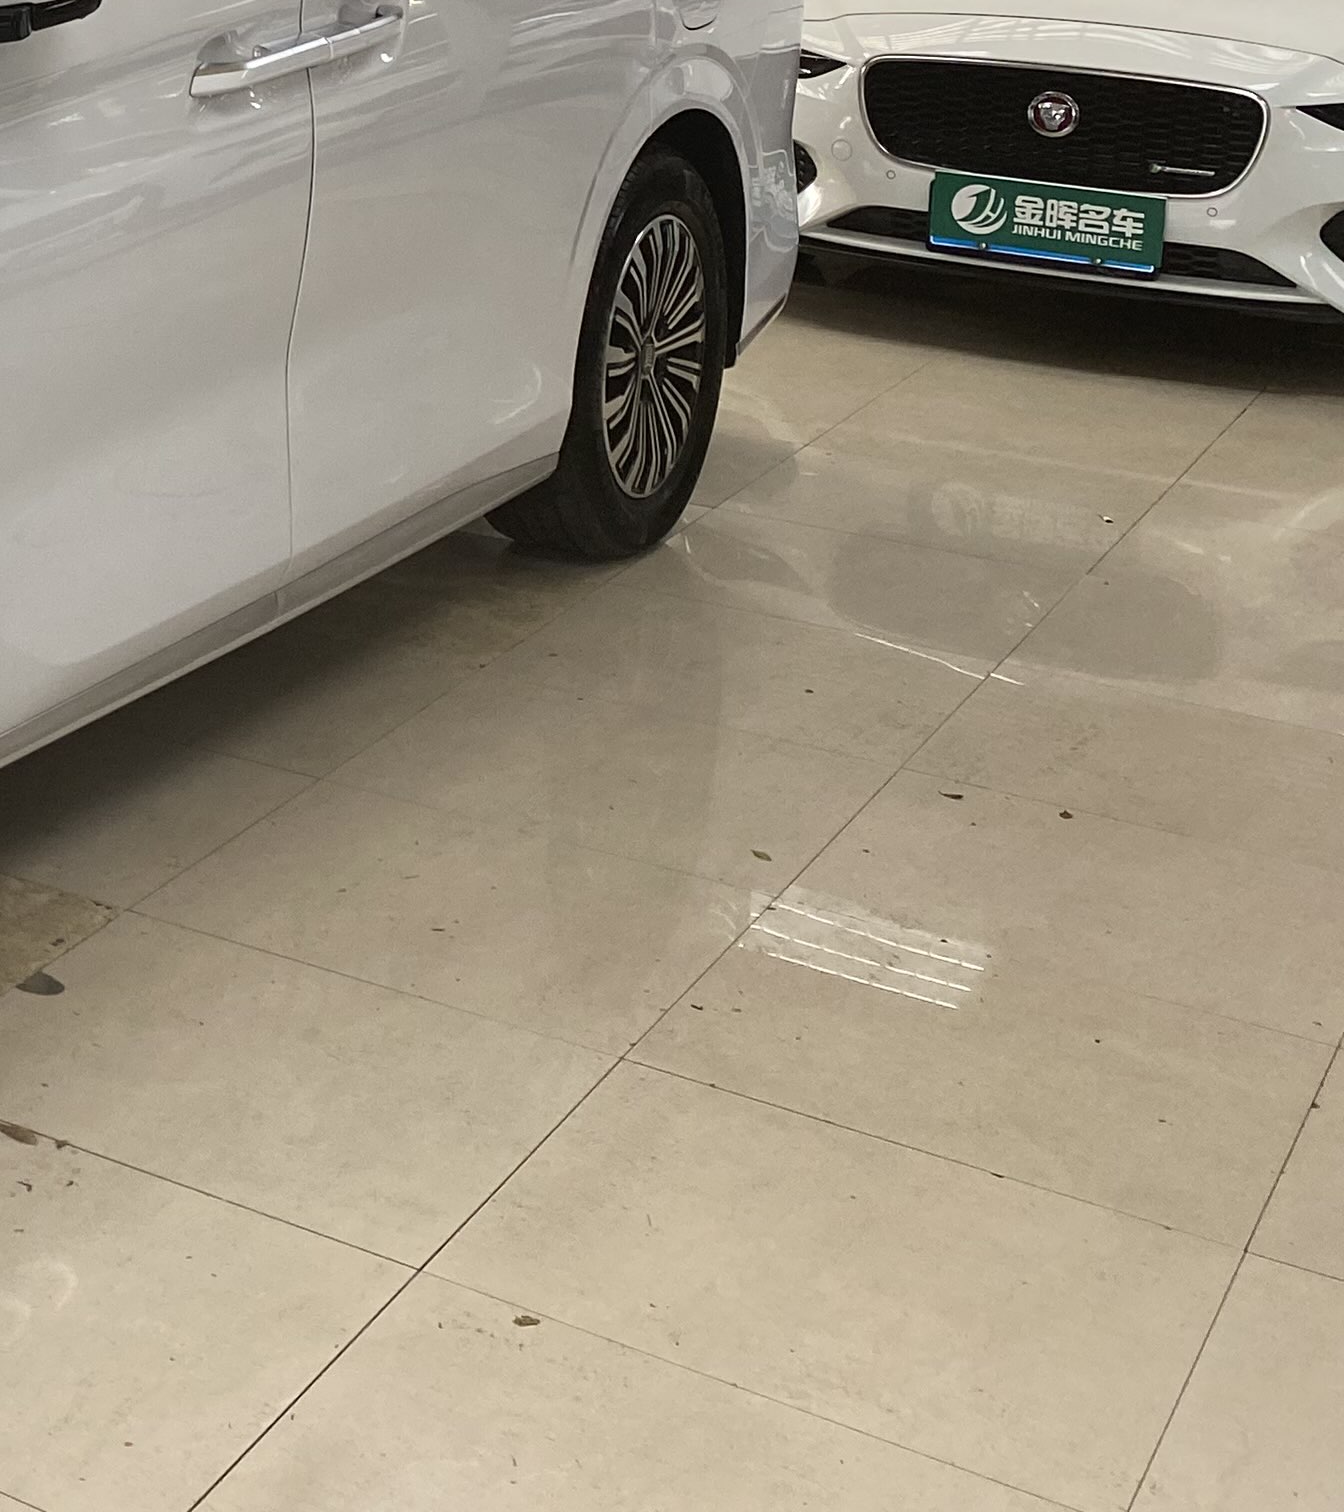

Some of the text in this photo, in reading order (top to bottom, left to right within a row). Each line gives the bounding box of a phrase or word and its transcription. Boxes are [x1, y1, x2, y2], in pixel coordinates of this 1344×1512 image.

[1013, 195, 1145, 237] 金晖名车
[1012, 225, 1144, 252] JINHUI MINGCHE
